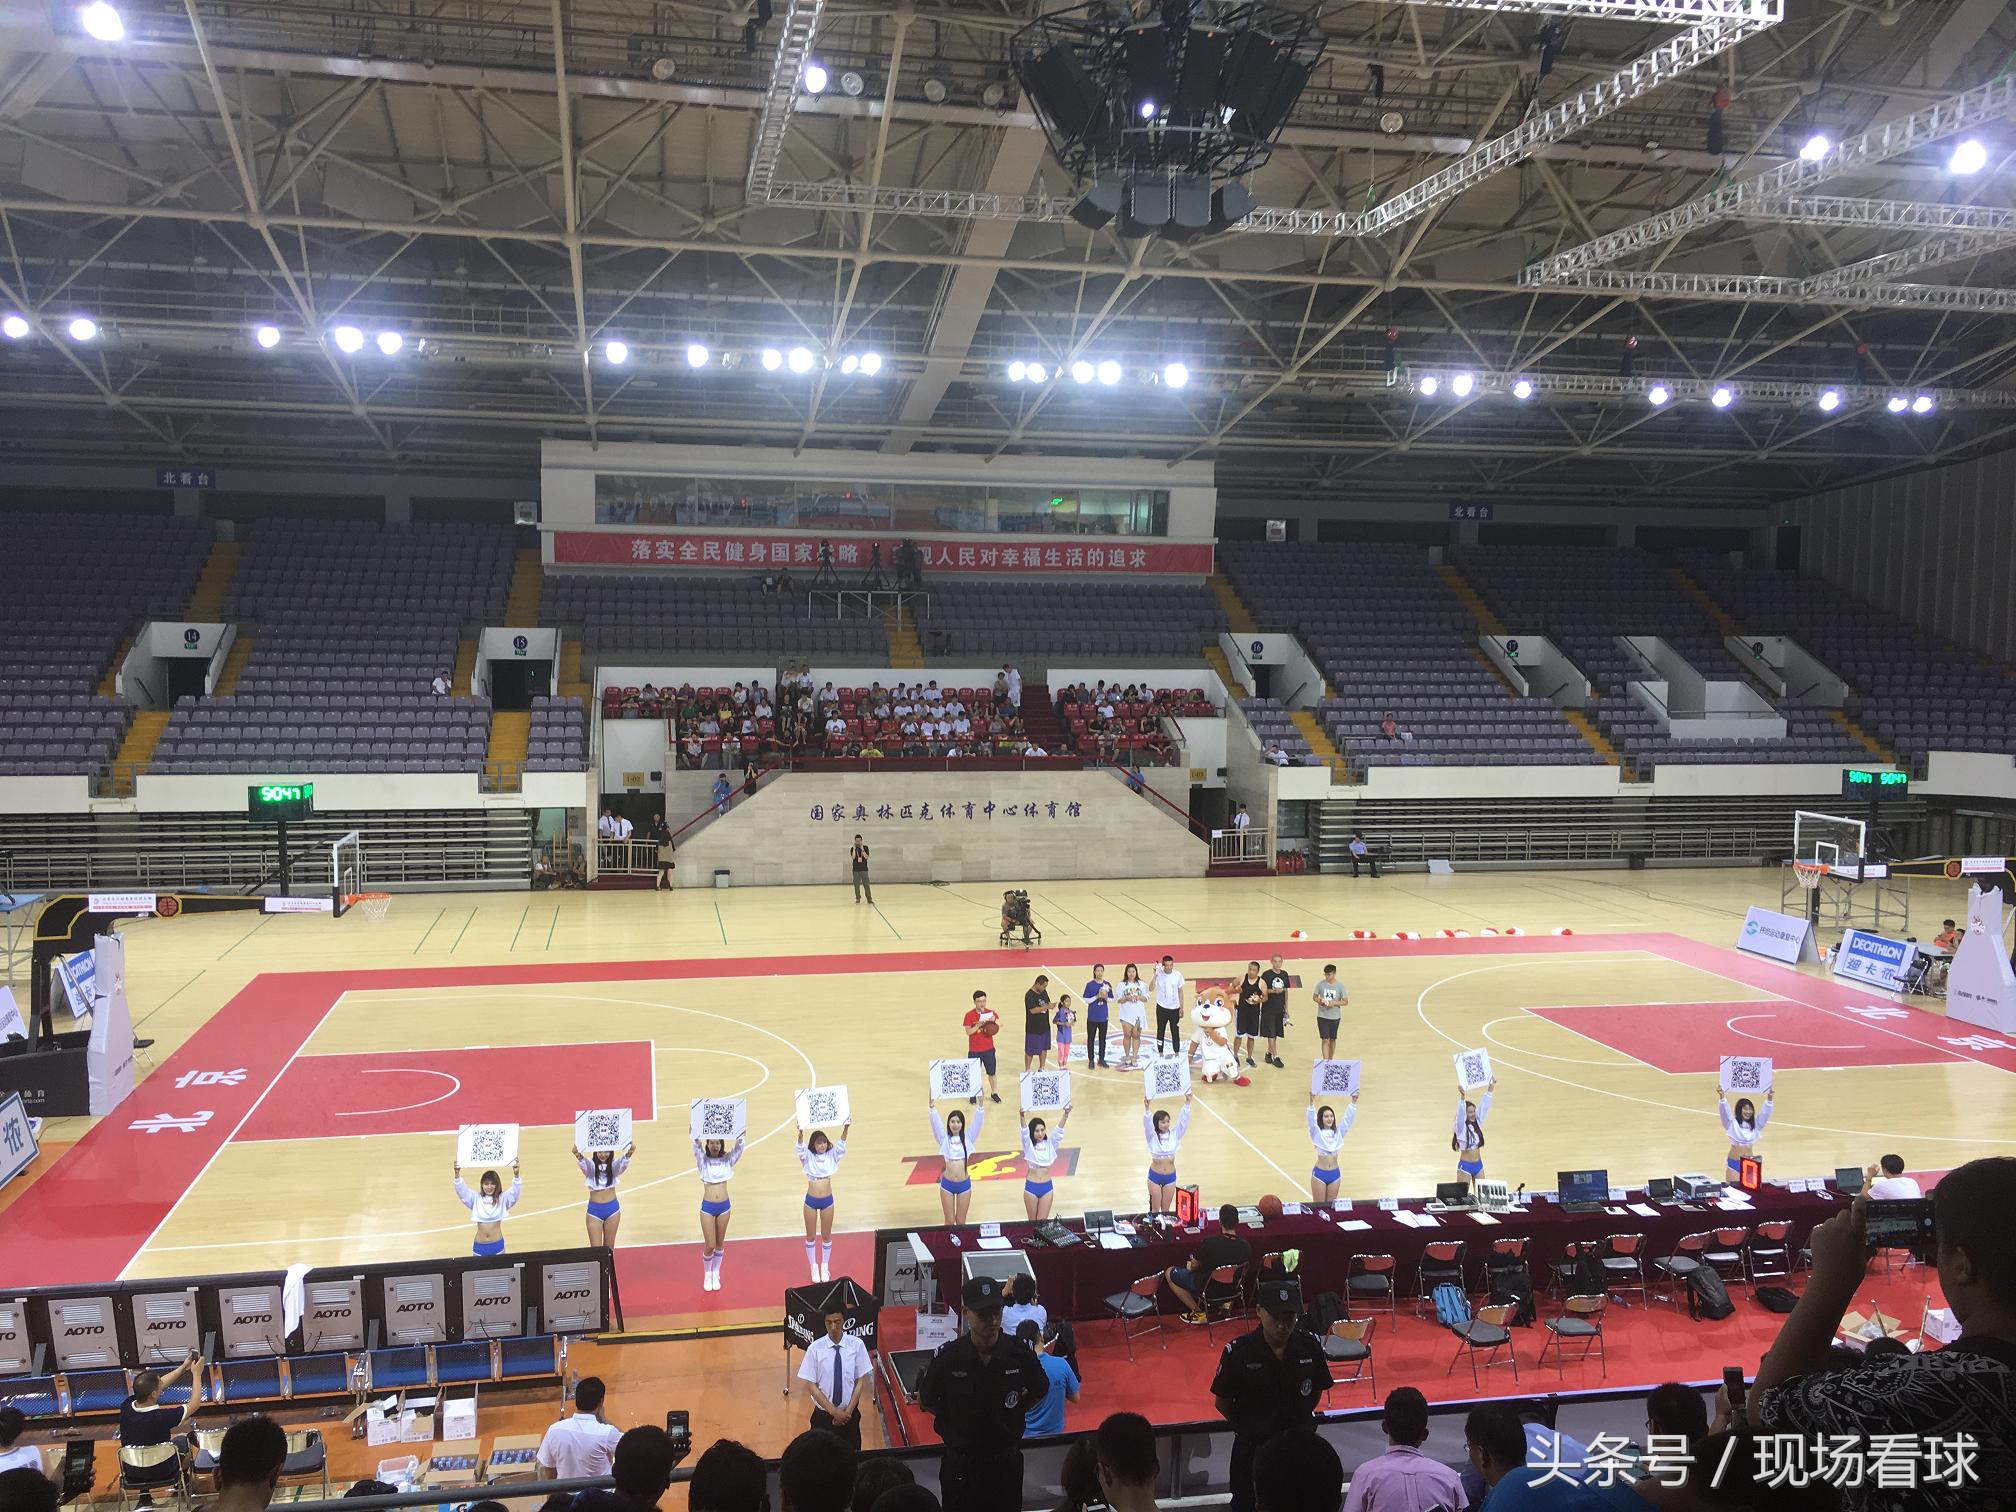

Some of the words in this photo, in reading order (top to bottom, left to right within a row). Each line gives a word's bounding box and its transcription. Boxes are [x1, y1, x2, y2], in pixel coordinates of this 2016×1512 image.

[163, 471, 209, 486] 北看台
[810, 801, 1083, 821] 国家奥林匹克体育中心体育馆
[1852, 936, 1903, 961] DECATHLON
[1846, 958, 1896, 983] 迪卡侬
[3, 1117, 24, 1156] 侬
[1742, 1159, 1758, 1189] 0
[1177, 1189, 1191, 1222] 0
[474, 1296, 511, 1307] AOTO
[554, 1289, 590, 1300] AOTO
[313, 1309, 351, 1319] AOTO
[396, 1302, 434, 1312] AOTO
[147, 1320, 187, 1331] AOTO
[233, 1314, 272, 1325] AOTO
[64, 1325, 104, 1336] AOTO
[788, 1314, 815, 1344] SPALDING
